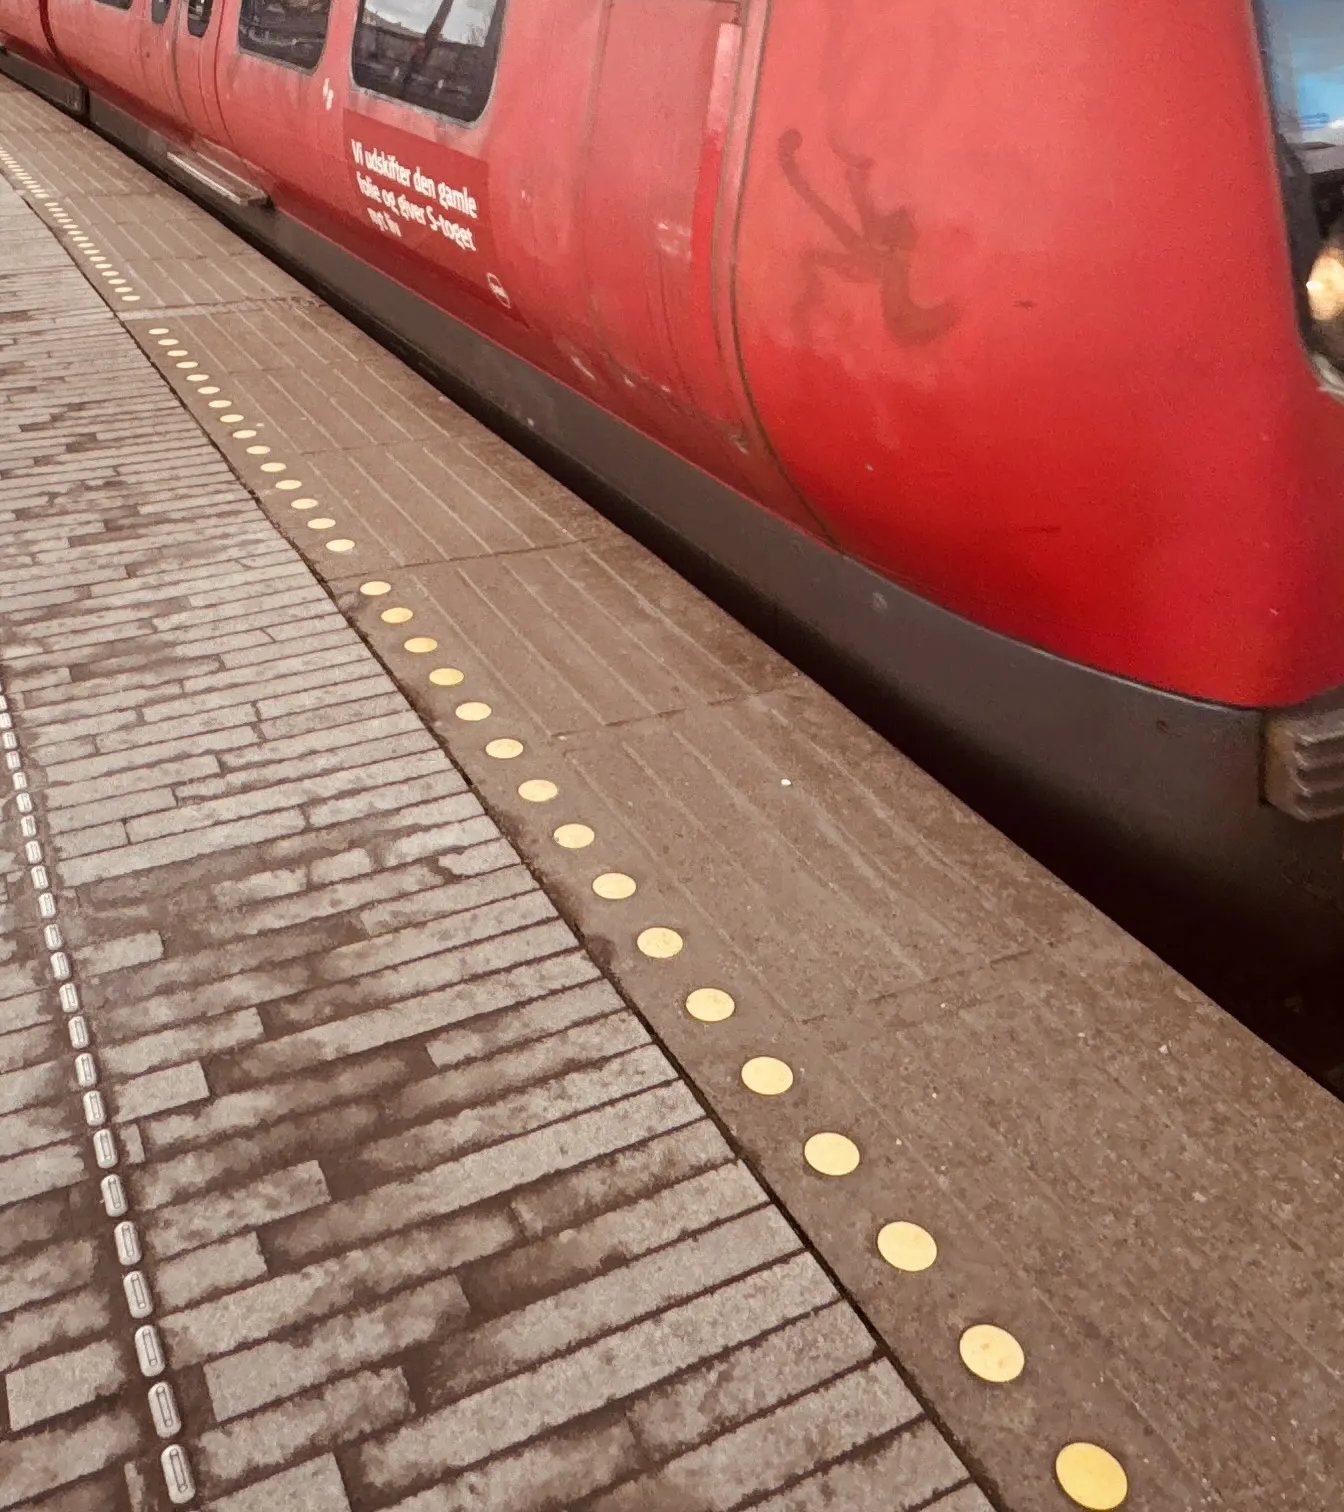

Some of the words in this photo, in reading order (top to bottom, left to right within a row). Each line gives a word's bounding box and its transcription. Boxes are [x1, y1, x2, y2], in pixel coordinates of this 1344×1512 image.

[351, 138, 364, 166] Vi
[364, 147, 411, 187] udskifter
[413, 166, 436, 199] den
[437, 182, 478, 219] gamle
[425, 205, 477, 251] S-toget
